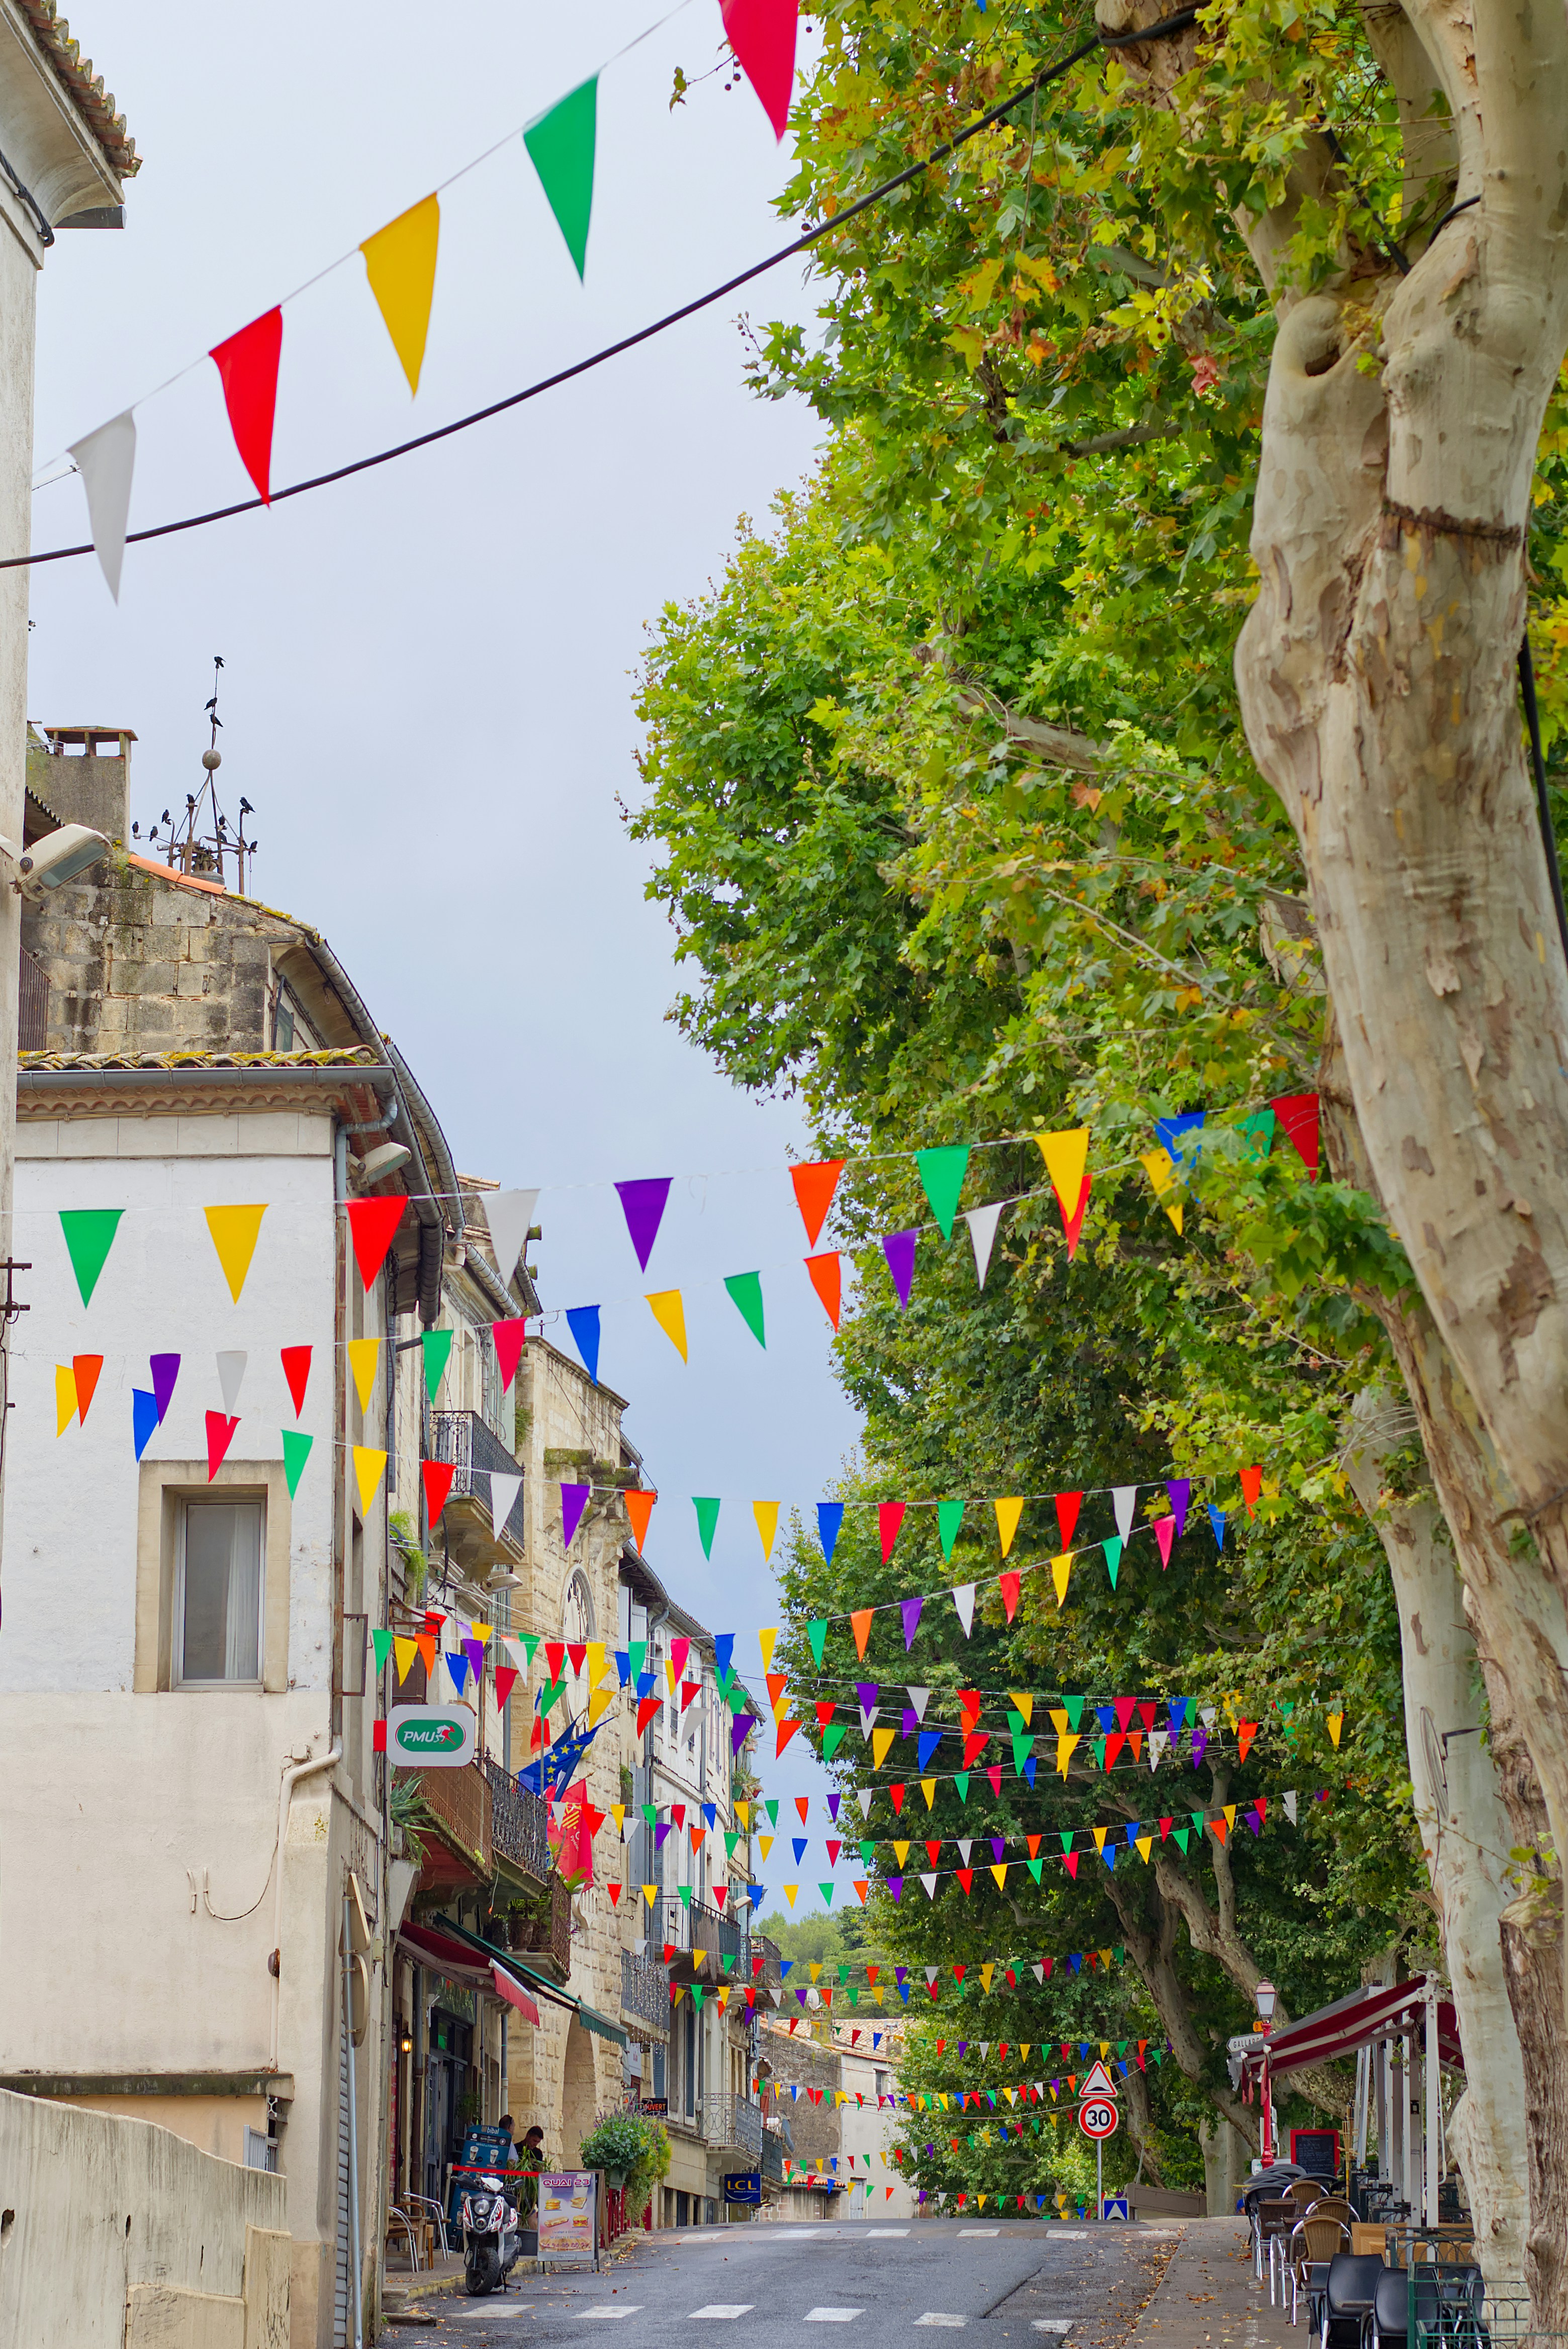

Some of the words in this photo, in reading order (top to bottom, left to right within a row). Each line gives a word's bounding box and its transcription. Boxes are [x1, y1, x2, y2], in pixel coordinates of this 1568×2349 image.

[403, 1731, 435, 1742] PMU
[1087, 2109, 1110, 2126] 30
[487, 2126, 499, 2134] bibal
[727, 2180, 757, 2190] LCL
